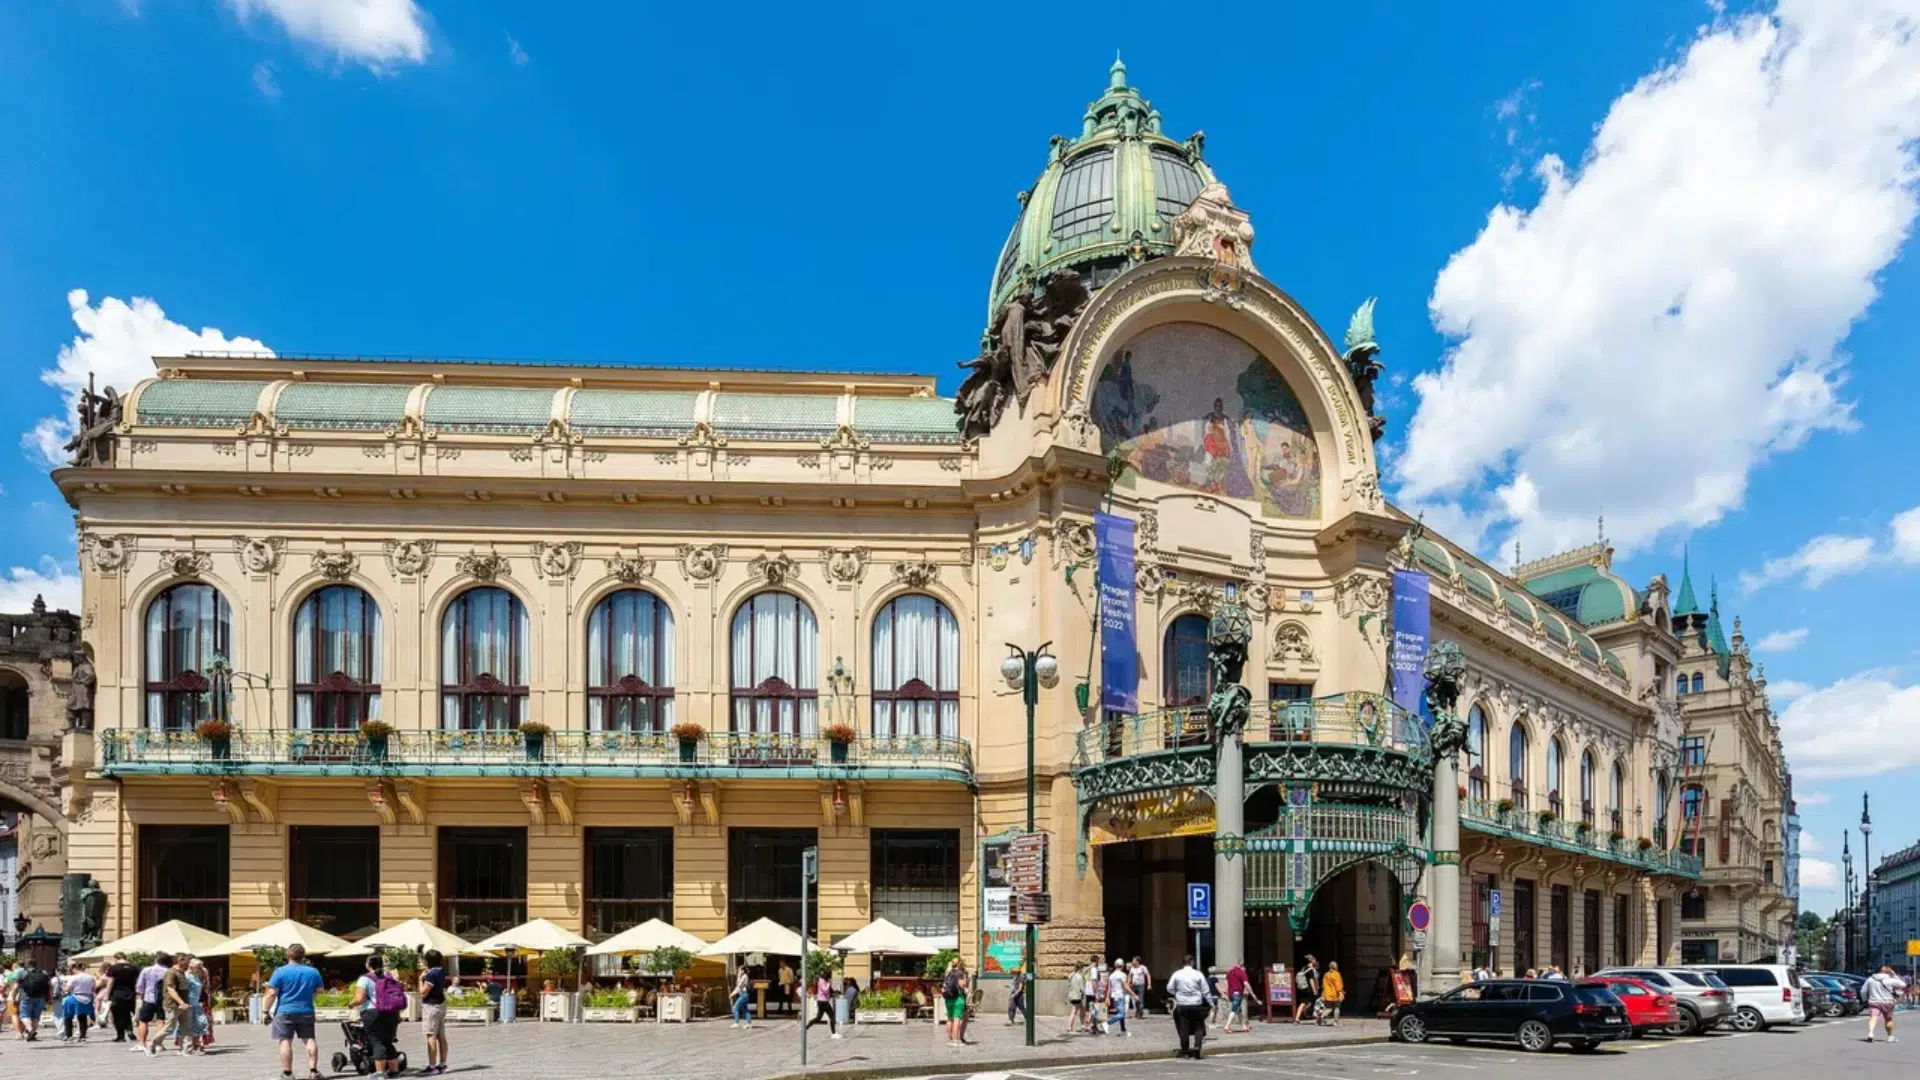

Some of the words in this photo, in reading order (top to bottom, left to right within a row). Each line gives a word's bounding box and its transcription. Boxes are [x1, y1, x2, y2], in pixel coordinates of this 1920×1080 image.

[1101, 583, 1129, 598] Prague
[1102, 594, 1128, 608] Proms
[1103, 606, 1132, 620] Festival
[1103, 619, 1124, 631] 2022
[1396, 631, 1424, 642] Prague
[1396, 641, 1422, 651] Proms
[1395, 662, 1417, 671] 2022
[1194, 888, 1205, 908] P
